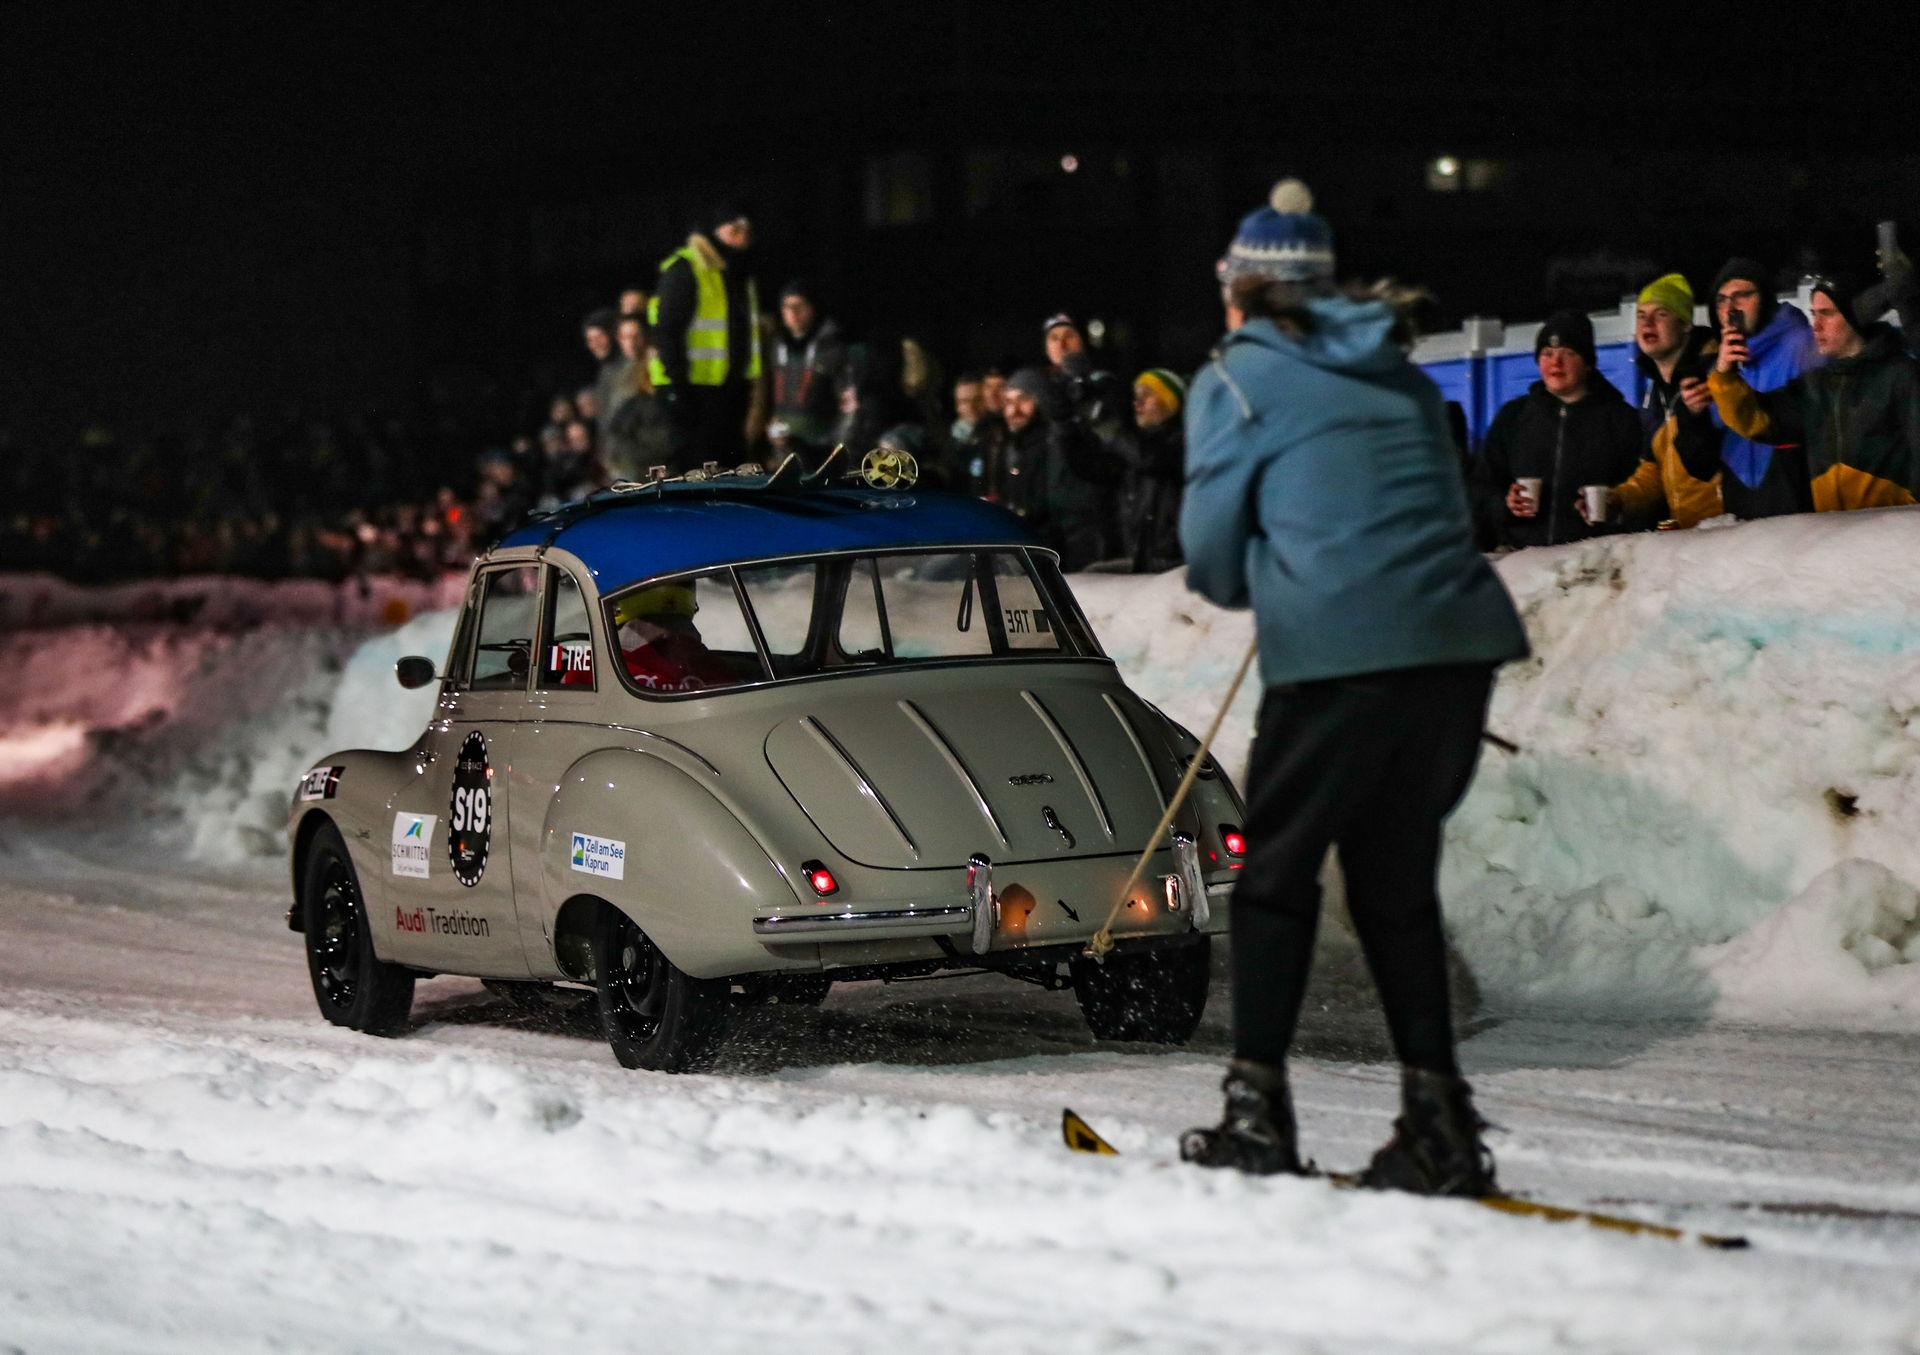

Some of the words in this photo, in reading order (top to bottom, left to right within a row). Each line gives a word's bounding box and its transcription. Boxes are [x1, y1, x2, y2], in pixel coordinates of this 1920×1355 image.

[566, 645, 591, 671] TRE
[453, 786, 487, 833] S19
[393, 844, 429, 860] SCHMITTEN
[586, 838, 599, 854] Zell
[599, 845, 609, 856] am
[610, 843, 624, 859] See
[585, 853, 609, 873] Kaprun
[396, 905, 426, 933] Audi
[427, 907, 490, 937] Tradition
